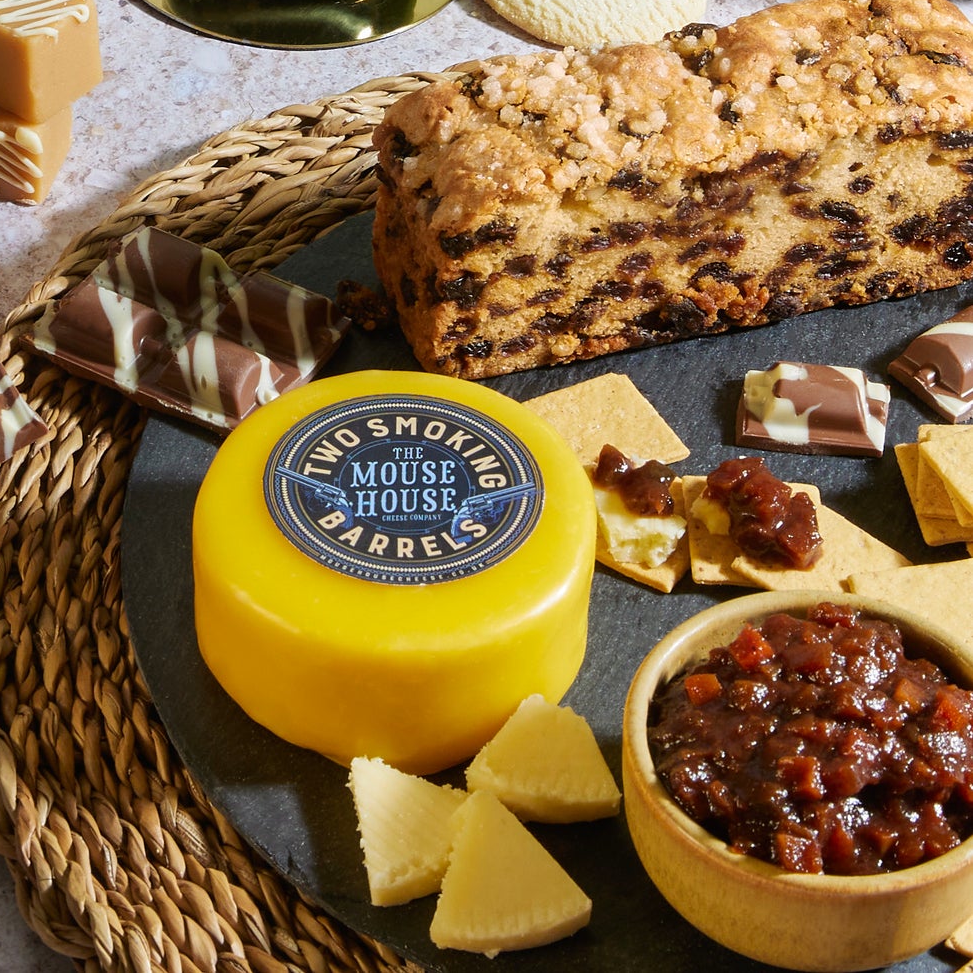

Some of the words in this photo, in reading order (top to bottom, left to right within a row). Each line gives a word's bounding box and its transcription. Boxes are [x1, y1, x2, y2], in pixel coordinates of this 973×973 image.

[303, 428, 361, 477] TWO
[366, 416, 508, 489] SMOKING
[392, 447, 424, 460] THE
[350, 460, 456, 488] MOUSE
[354, 488, 457, 517] HOUSE
[382, 514, 408, 522] CHEESE
[409, 513, 442, 521] COMPANY
[317, 510, 488, 558] BARRELS
